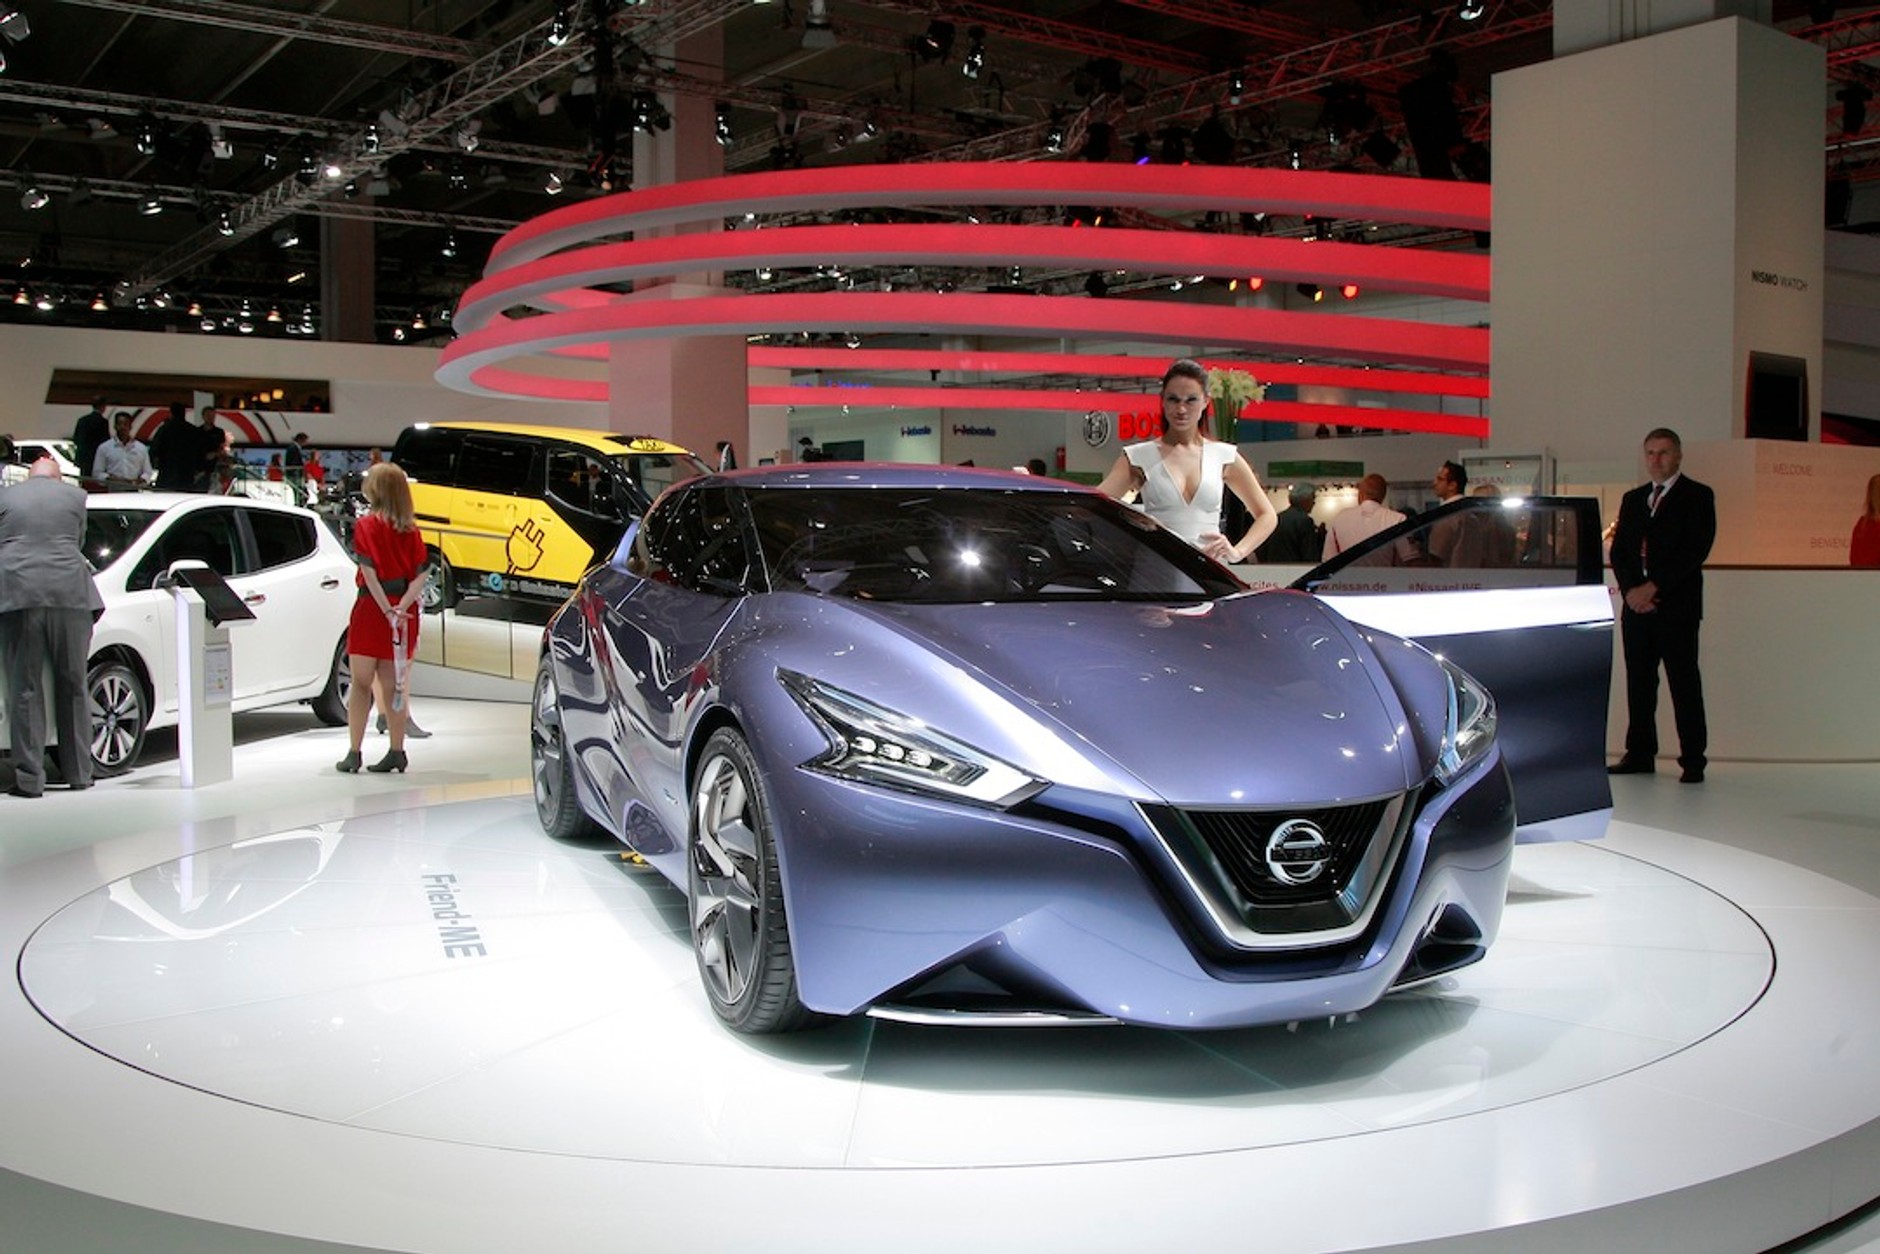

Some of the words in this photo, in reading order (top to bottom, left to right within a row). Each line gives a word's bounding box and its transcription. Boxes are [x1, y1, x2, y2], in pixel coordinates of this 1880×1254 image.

[1752, 270, 1779, 286] NISMO
[1779, 275, 1809, 291] WATCH
[1772, 463, 1813, 476] WELCOME
[421, 874, 488, 959] Friend-ME
